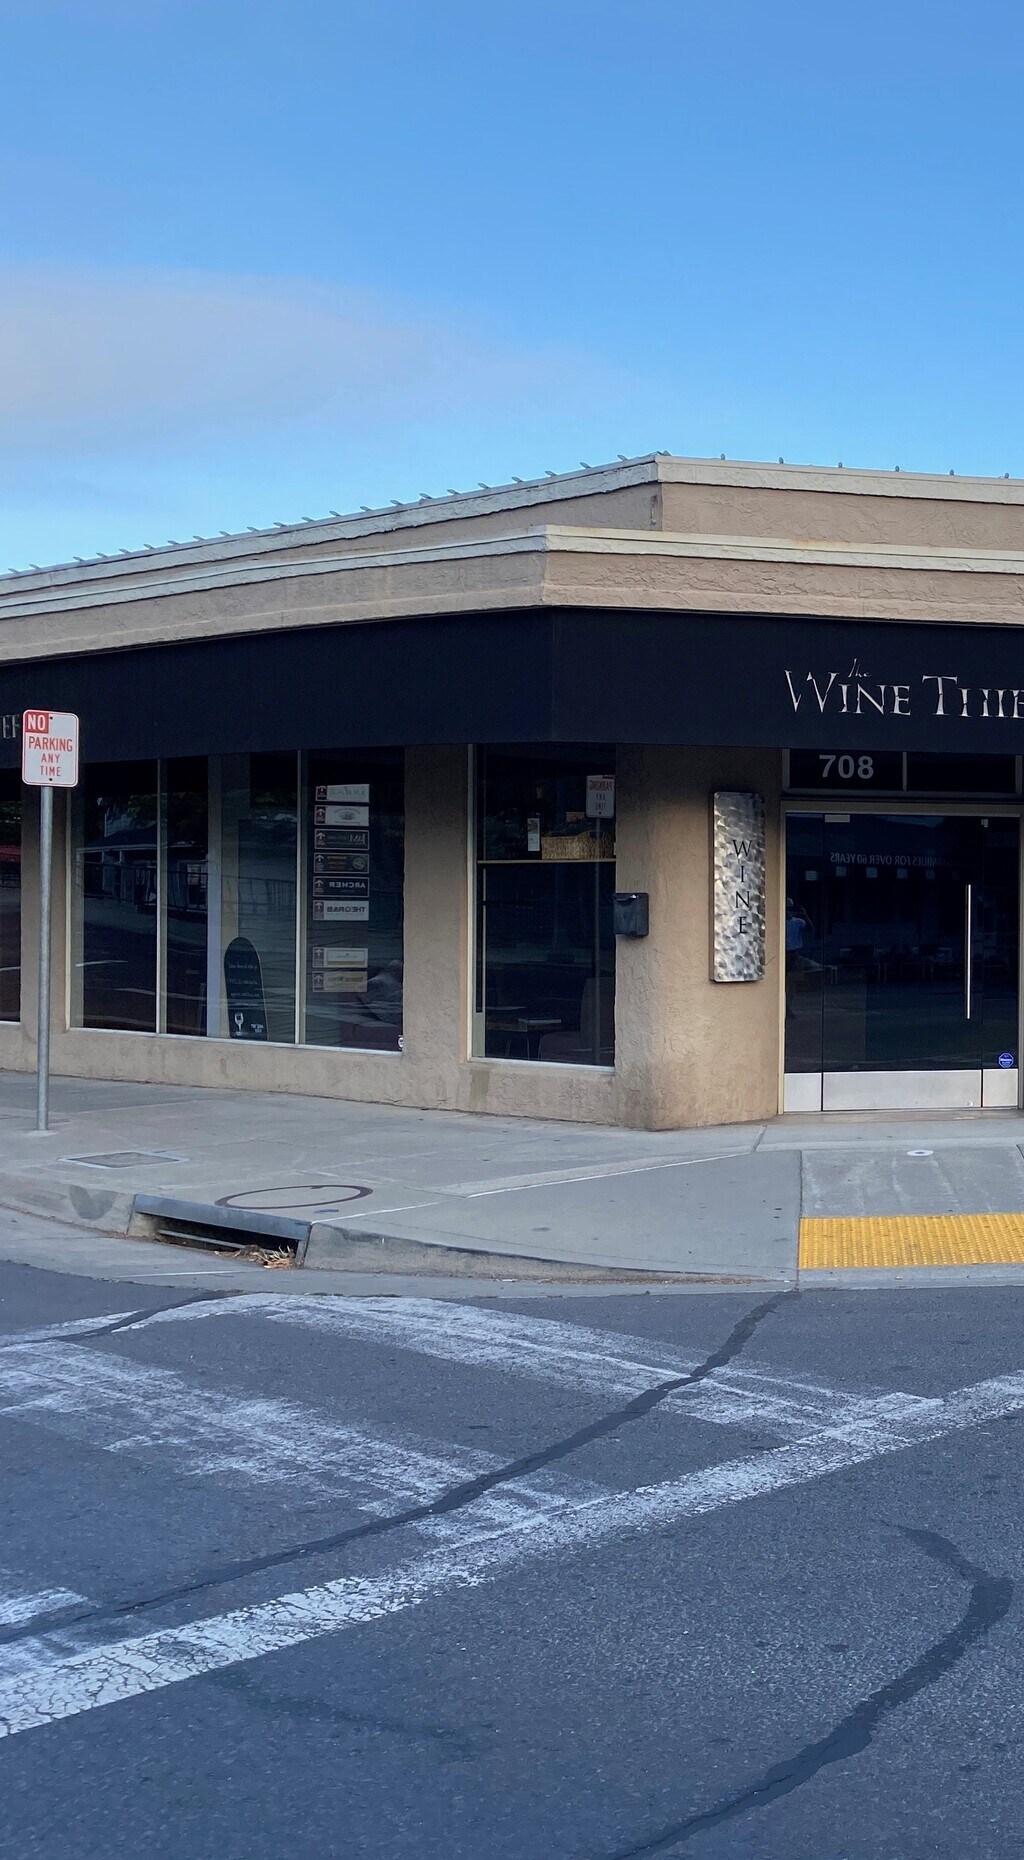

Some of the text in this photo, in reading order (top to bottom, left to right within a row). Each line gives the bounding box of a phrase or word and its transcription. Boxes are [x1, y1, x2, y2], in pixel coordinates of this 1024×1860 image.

[848, 658, 872, 678] The
[784, 670, 911, 716] WINE
[28, 714, 46, 730] NO
[28, 736, 72, 752] PARKING
[41, 753, 60, 763] ANY
[818, 754, 874, 779] 708
[40, 766, 60, 776] TIME
[732, 840, 753, 934] WINE
